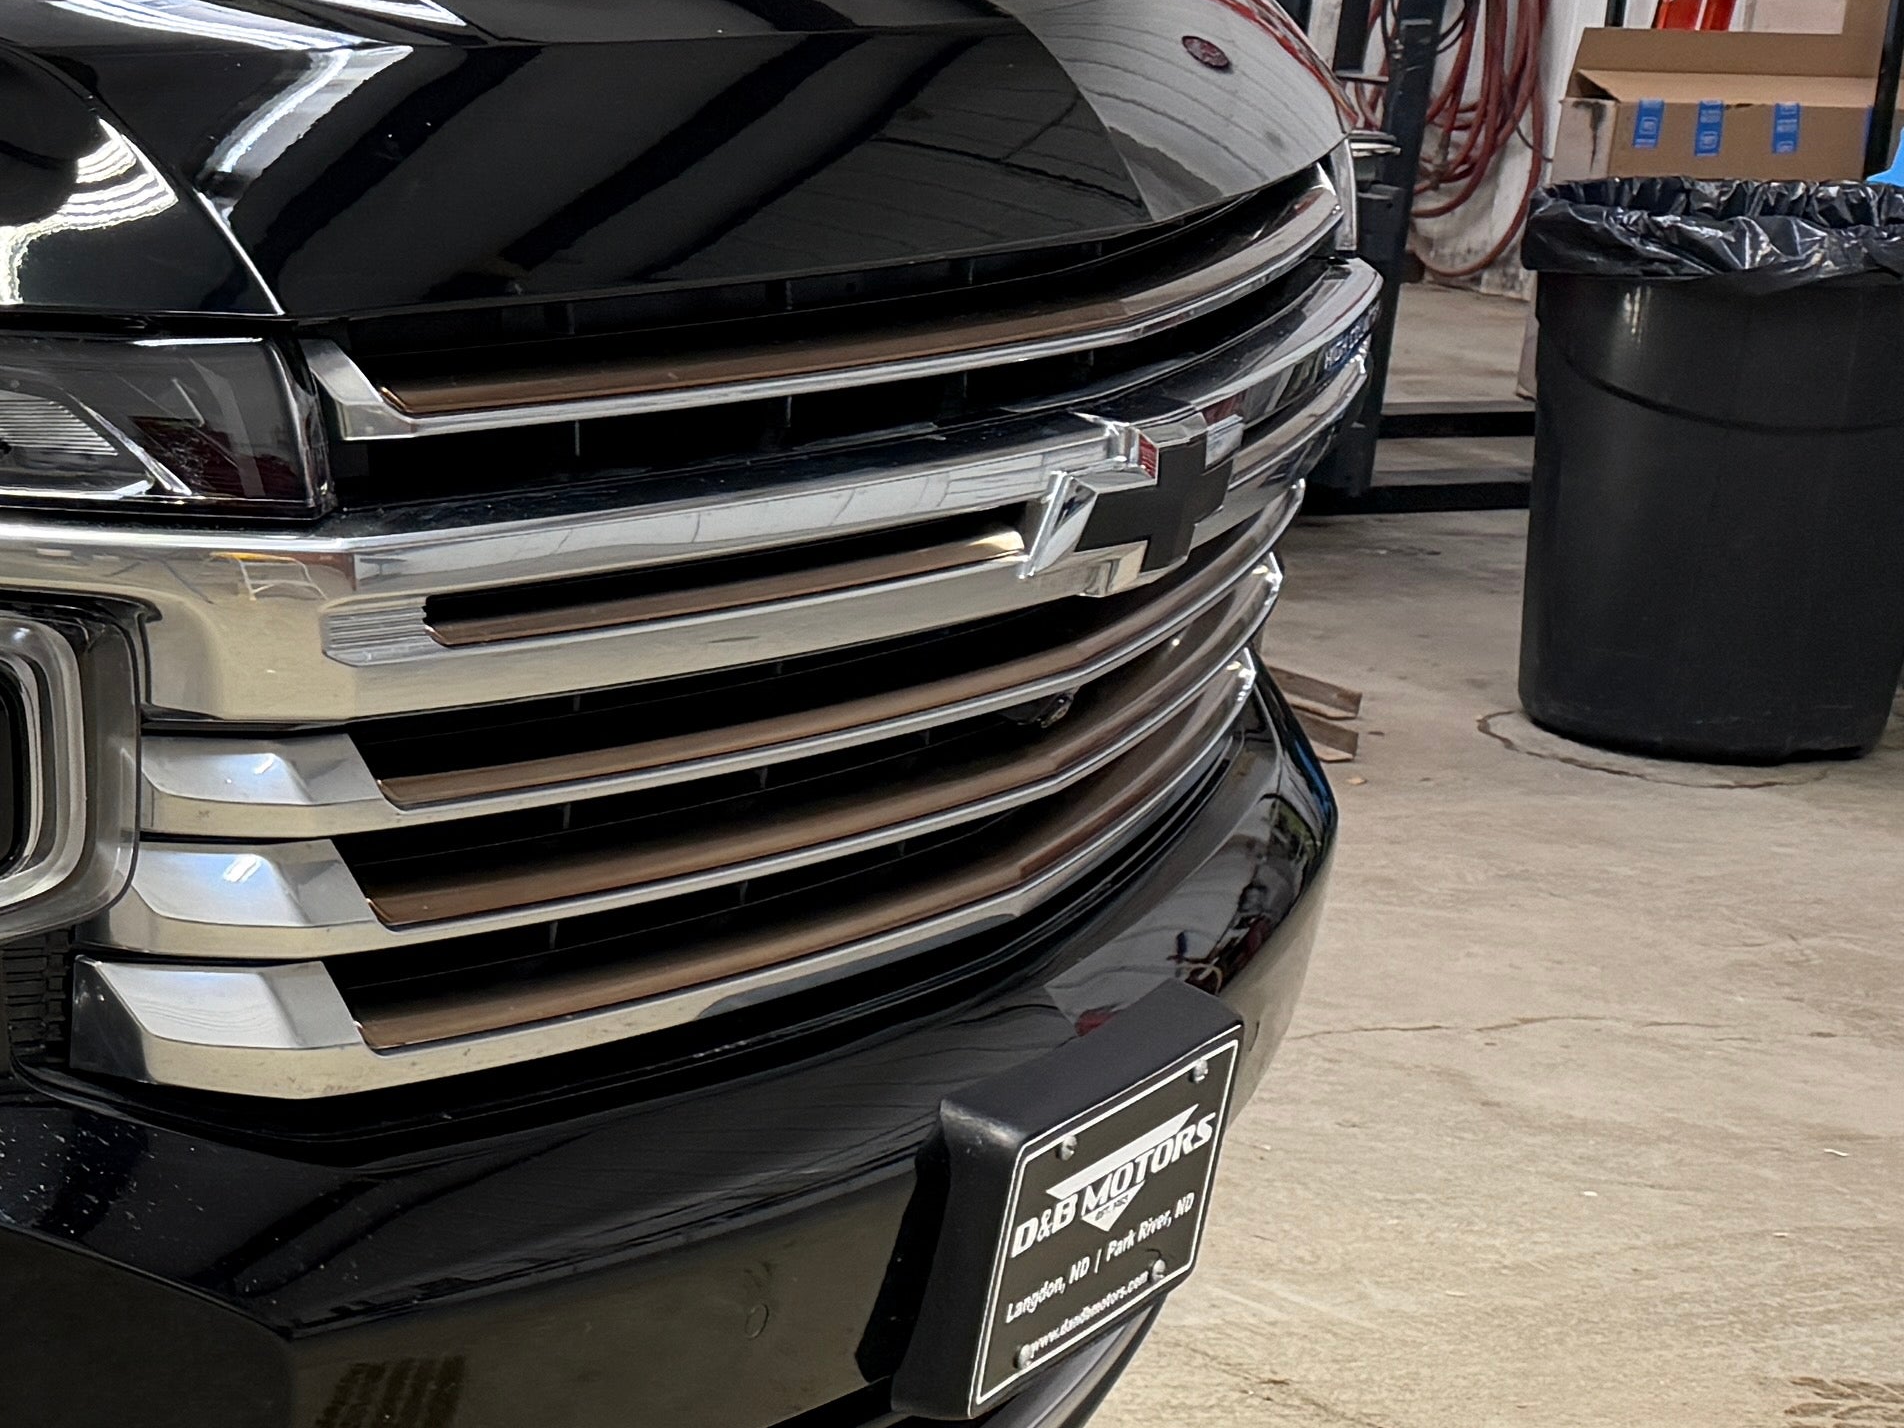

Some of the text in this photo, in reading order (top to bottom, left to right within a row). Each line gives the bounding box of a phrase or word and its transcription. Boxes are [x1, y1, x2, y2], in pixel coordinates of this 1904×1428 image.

[1010, 1112, 1216, 1259] D&B MOTORS
[1005, 1276, 1066, 1324] Langdon,
[1068, 1256, 1090, 1284] ND
[1106, 1230, 1135, 1262] Park
[1137, 1210, 1172, 1242] River,
[1174, 1192, 1195, 1219] ND
